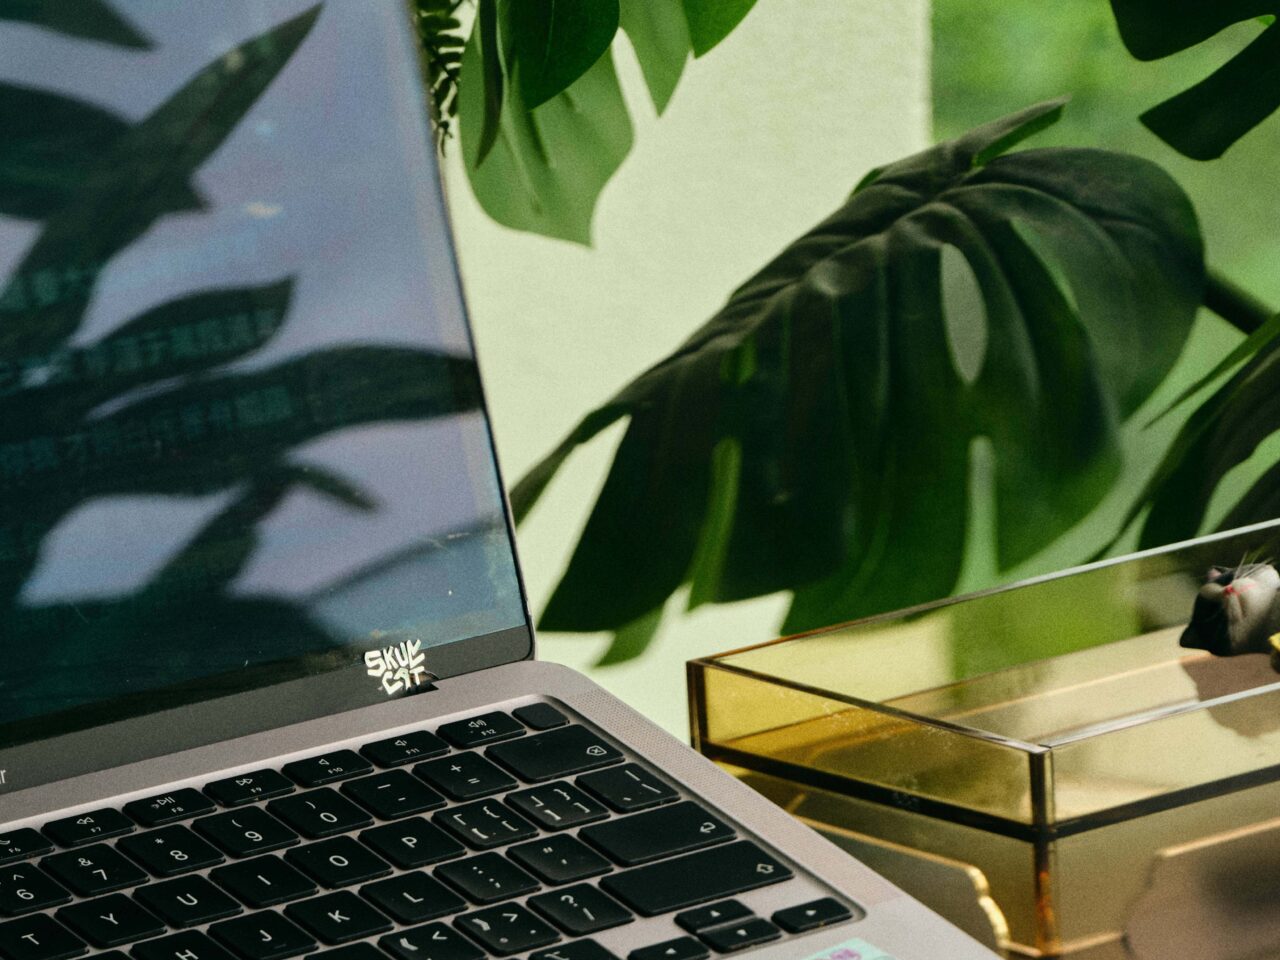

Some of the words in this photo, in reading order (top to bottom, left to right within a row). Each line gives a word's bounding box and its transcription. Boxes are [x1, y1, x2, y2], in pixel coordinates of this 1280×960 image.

[320, 813, 338, 823] 0
[245, 830, 263, 842] 9
[402, 836, 418, 848] P
[170, 850, 189, 861] 8
[329, 855, 348, 867] O
[92, 869, 108, 880] 7
[17, 889, 34, 900] 6
[177, 894, 198, 906] U
[403, 892, 424, 903] L
[100, 913, 119, 925] Y
[327, 910, 350, 923] K
[21, 933, 40, 945] T
[259, 930, 273, 942] J
